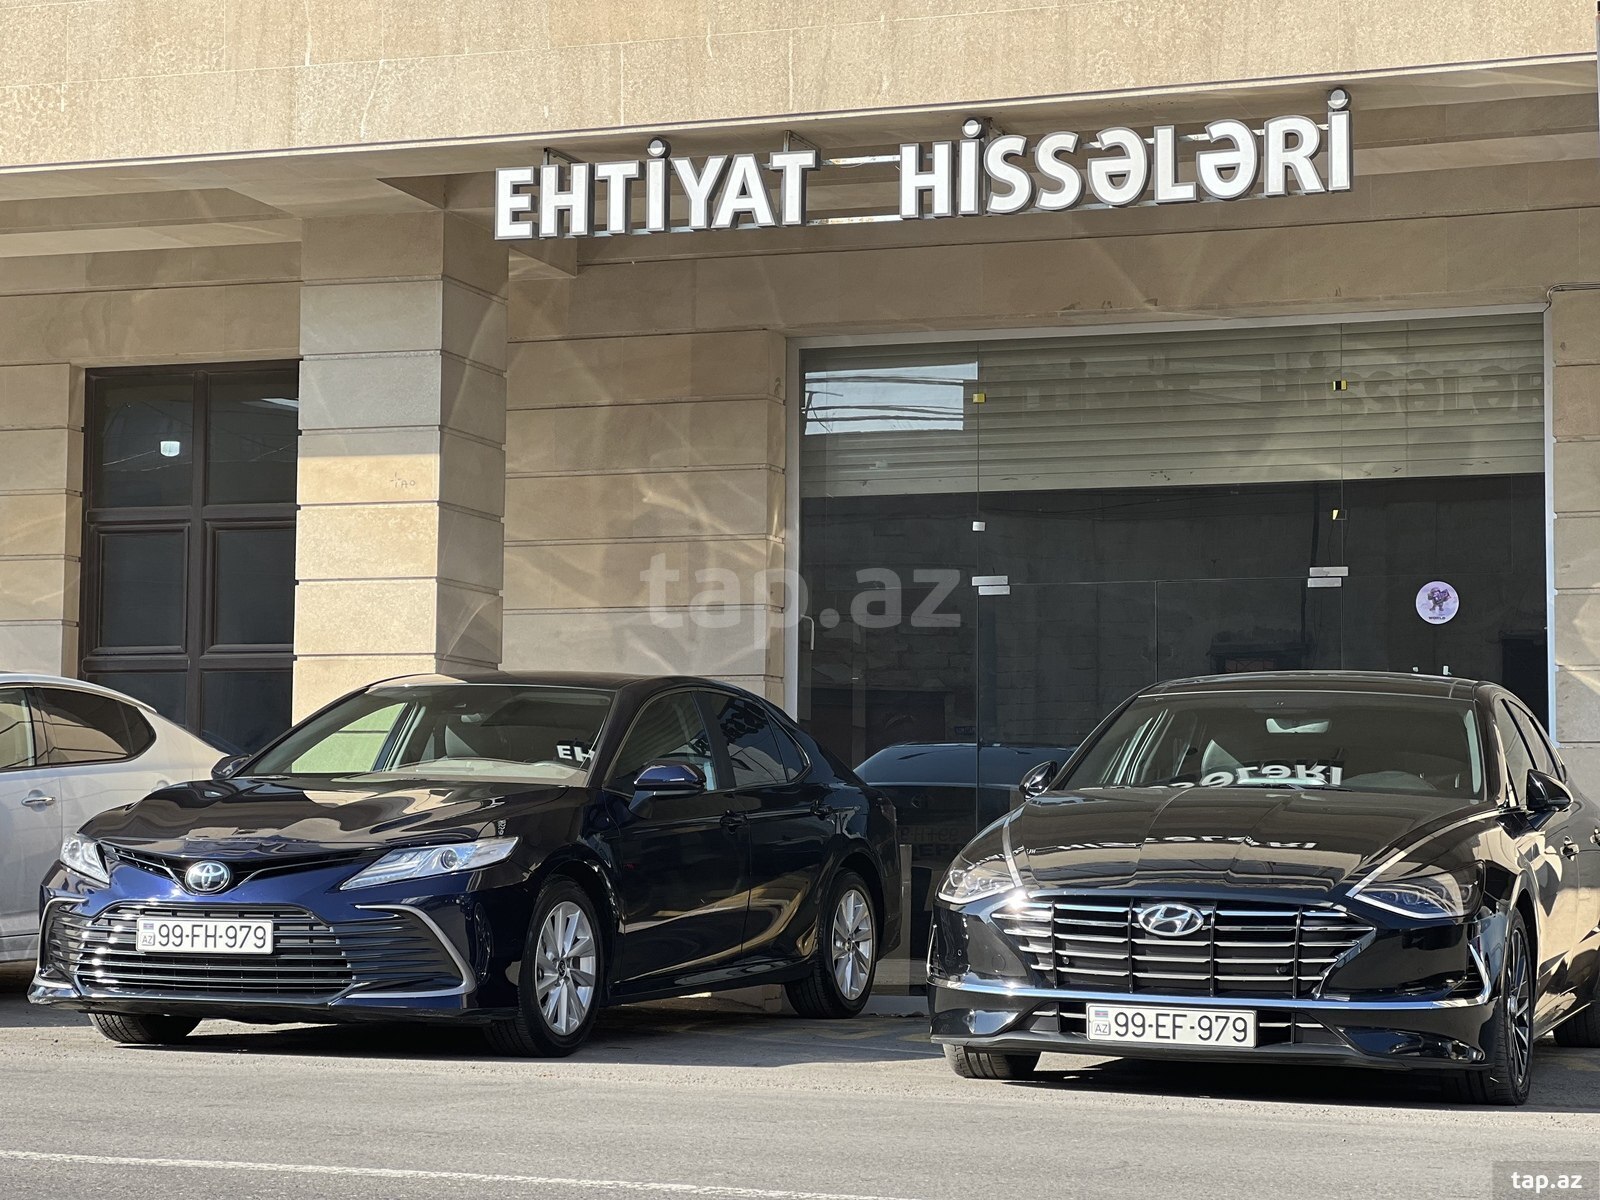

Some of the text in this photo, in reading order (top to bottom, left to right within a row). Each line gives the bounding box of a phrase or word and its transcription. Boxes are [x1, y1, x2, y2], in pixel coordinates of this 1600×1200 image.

[494, 88, 1351, 240] EHTİYAT HİSSƏLƏRİ
[141, 924, 267, 949] AZ 99-FH-979
[1094, 1011, 1248, 1042] AZ 99-EF-979
